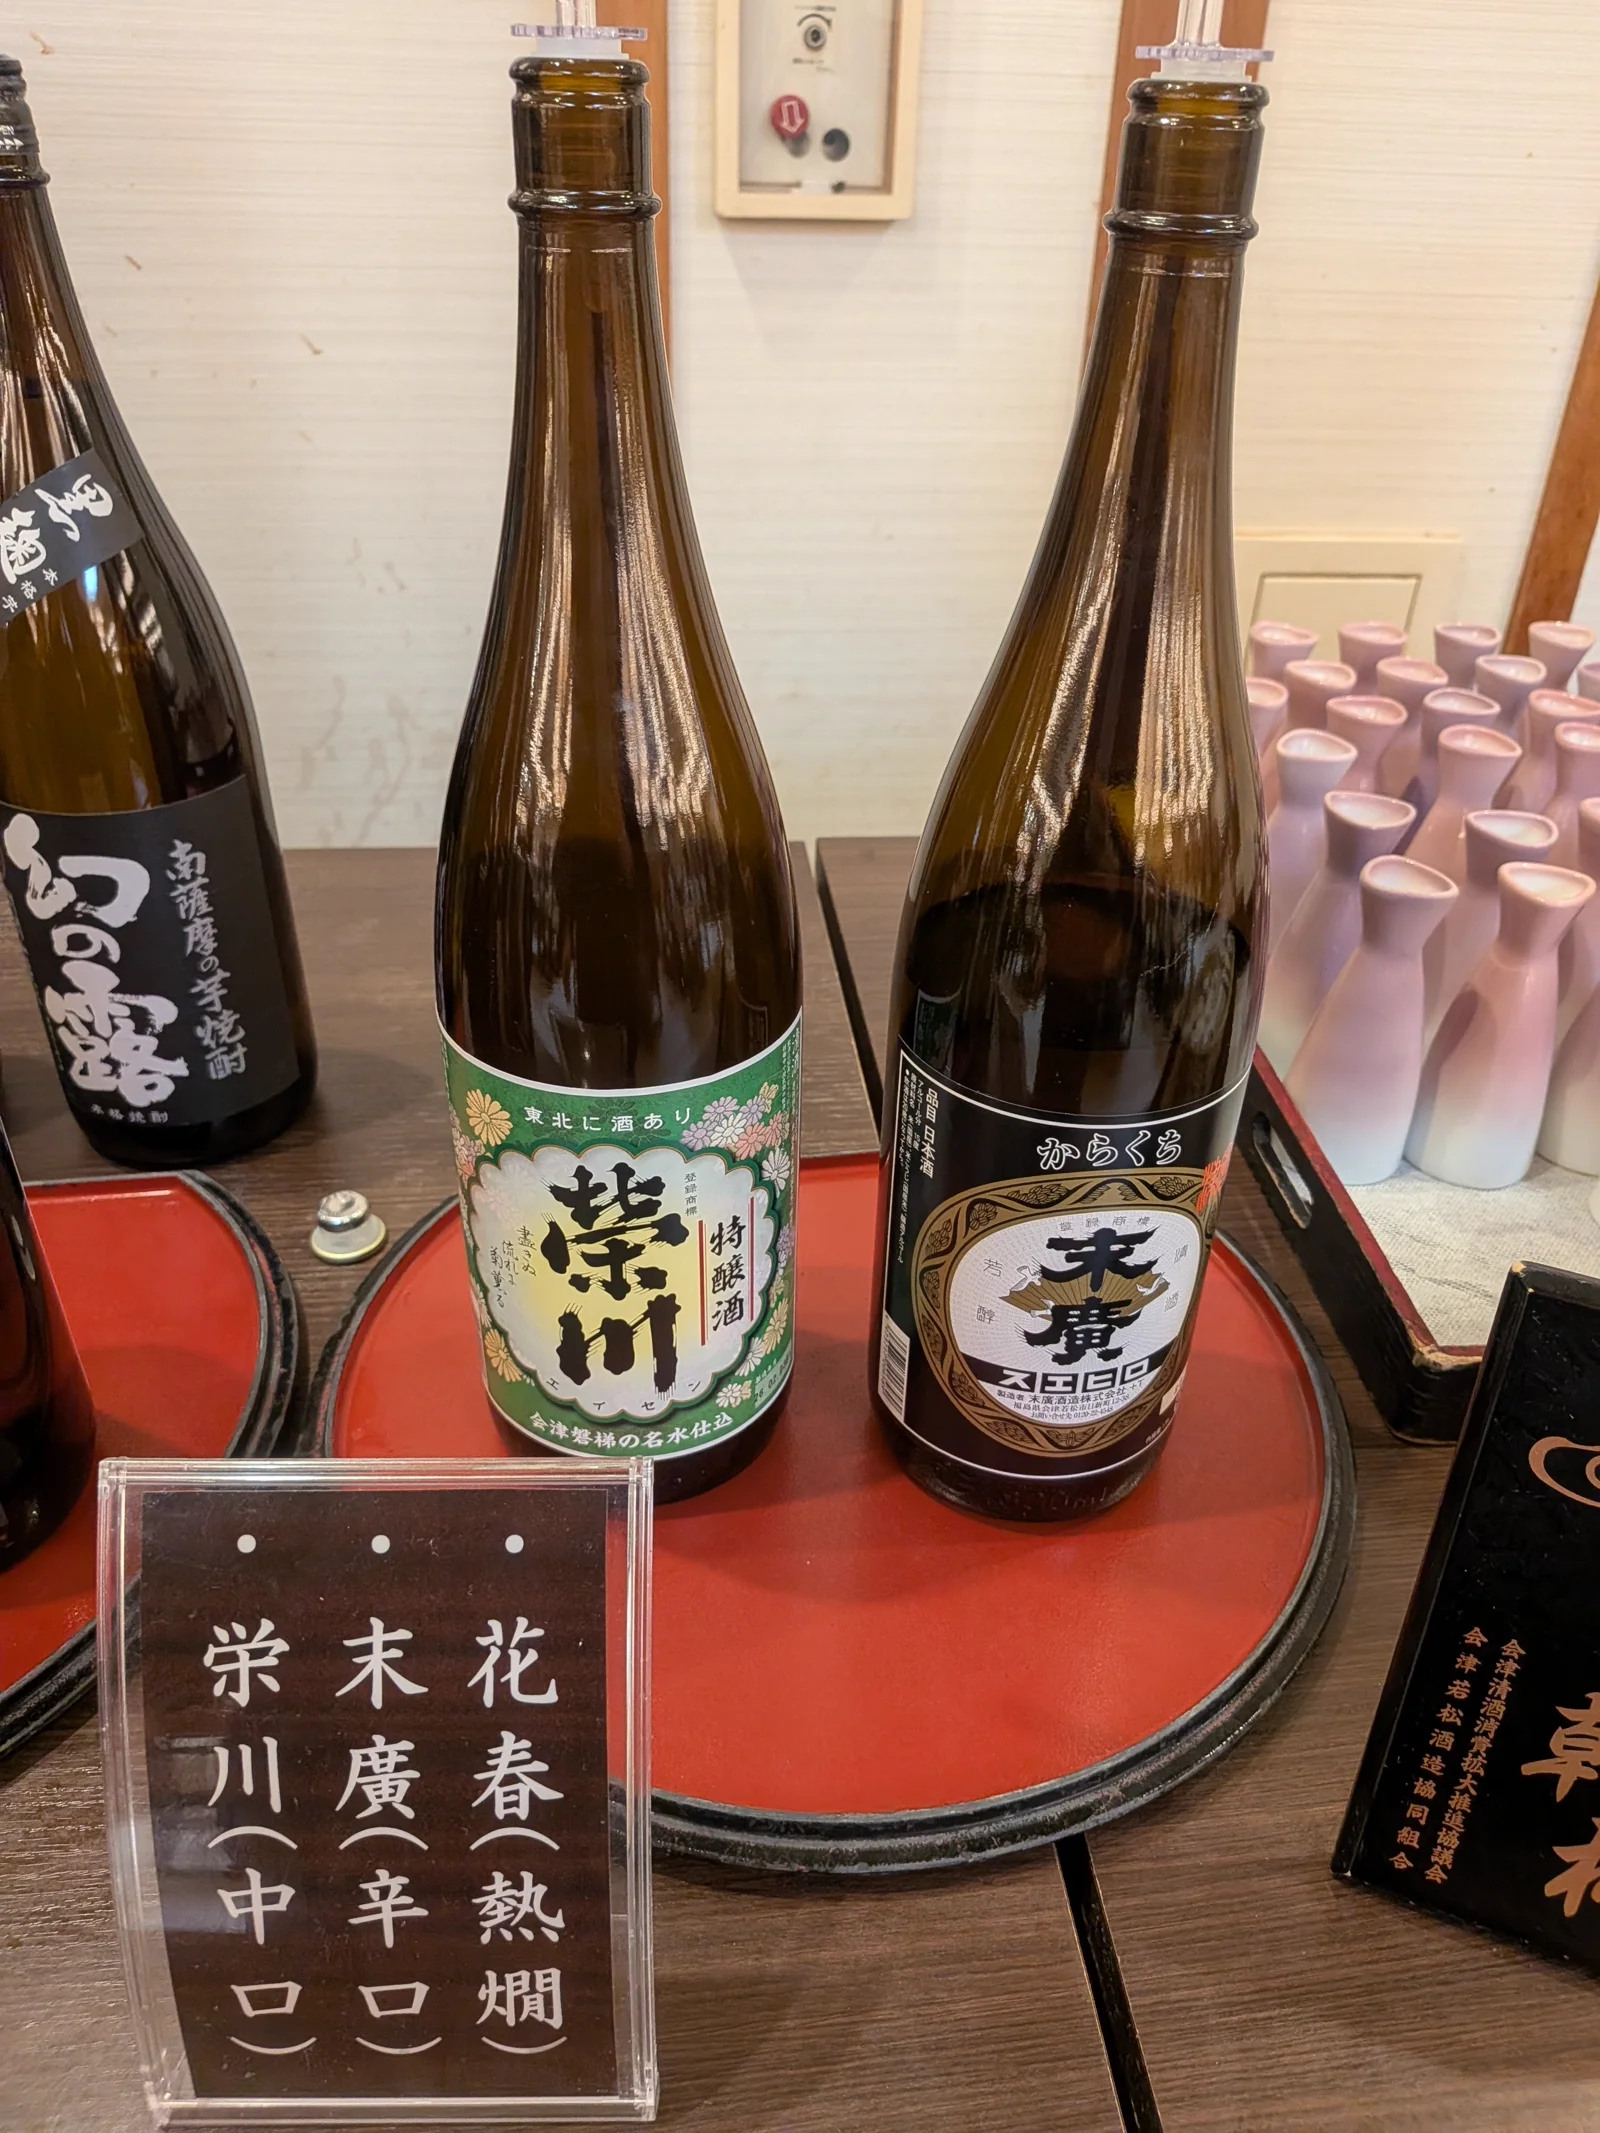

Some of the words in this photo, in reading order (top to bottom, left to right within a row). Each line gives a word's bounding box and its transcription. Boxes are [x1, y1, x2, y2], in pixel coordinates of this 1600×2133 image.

[166, 839, 248, 1080] 南薩摩の芋焼酎
[524, 1106, 691, 1132] 東北に酒あり
[915, 1079, 924, 1126] アルコール分
[926, 1088, 939, 1123] 品目
[920, 1124, 936, 1179] 日本酒
[1036, 1129, 1182, 1170] からくち
[684, 1172, 698, 1216] 登録商標
[1059, 1216, 1151, 1232] 登録商標
[1015, 1224, 1160, 1366] 末廣
[998, 1357, 1151, 1391] スエヒロ
[997, 1389, 1025, 1402] 製造者
[1029, 1386, 1127, 1405] 末廣酒造株式会社
[529, 1411, 734, 1448] 会津磐梯の名水仕込
[1388, 1626, 1489, 1870] 会津若松酒造協同組合
